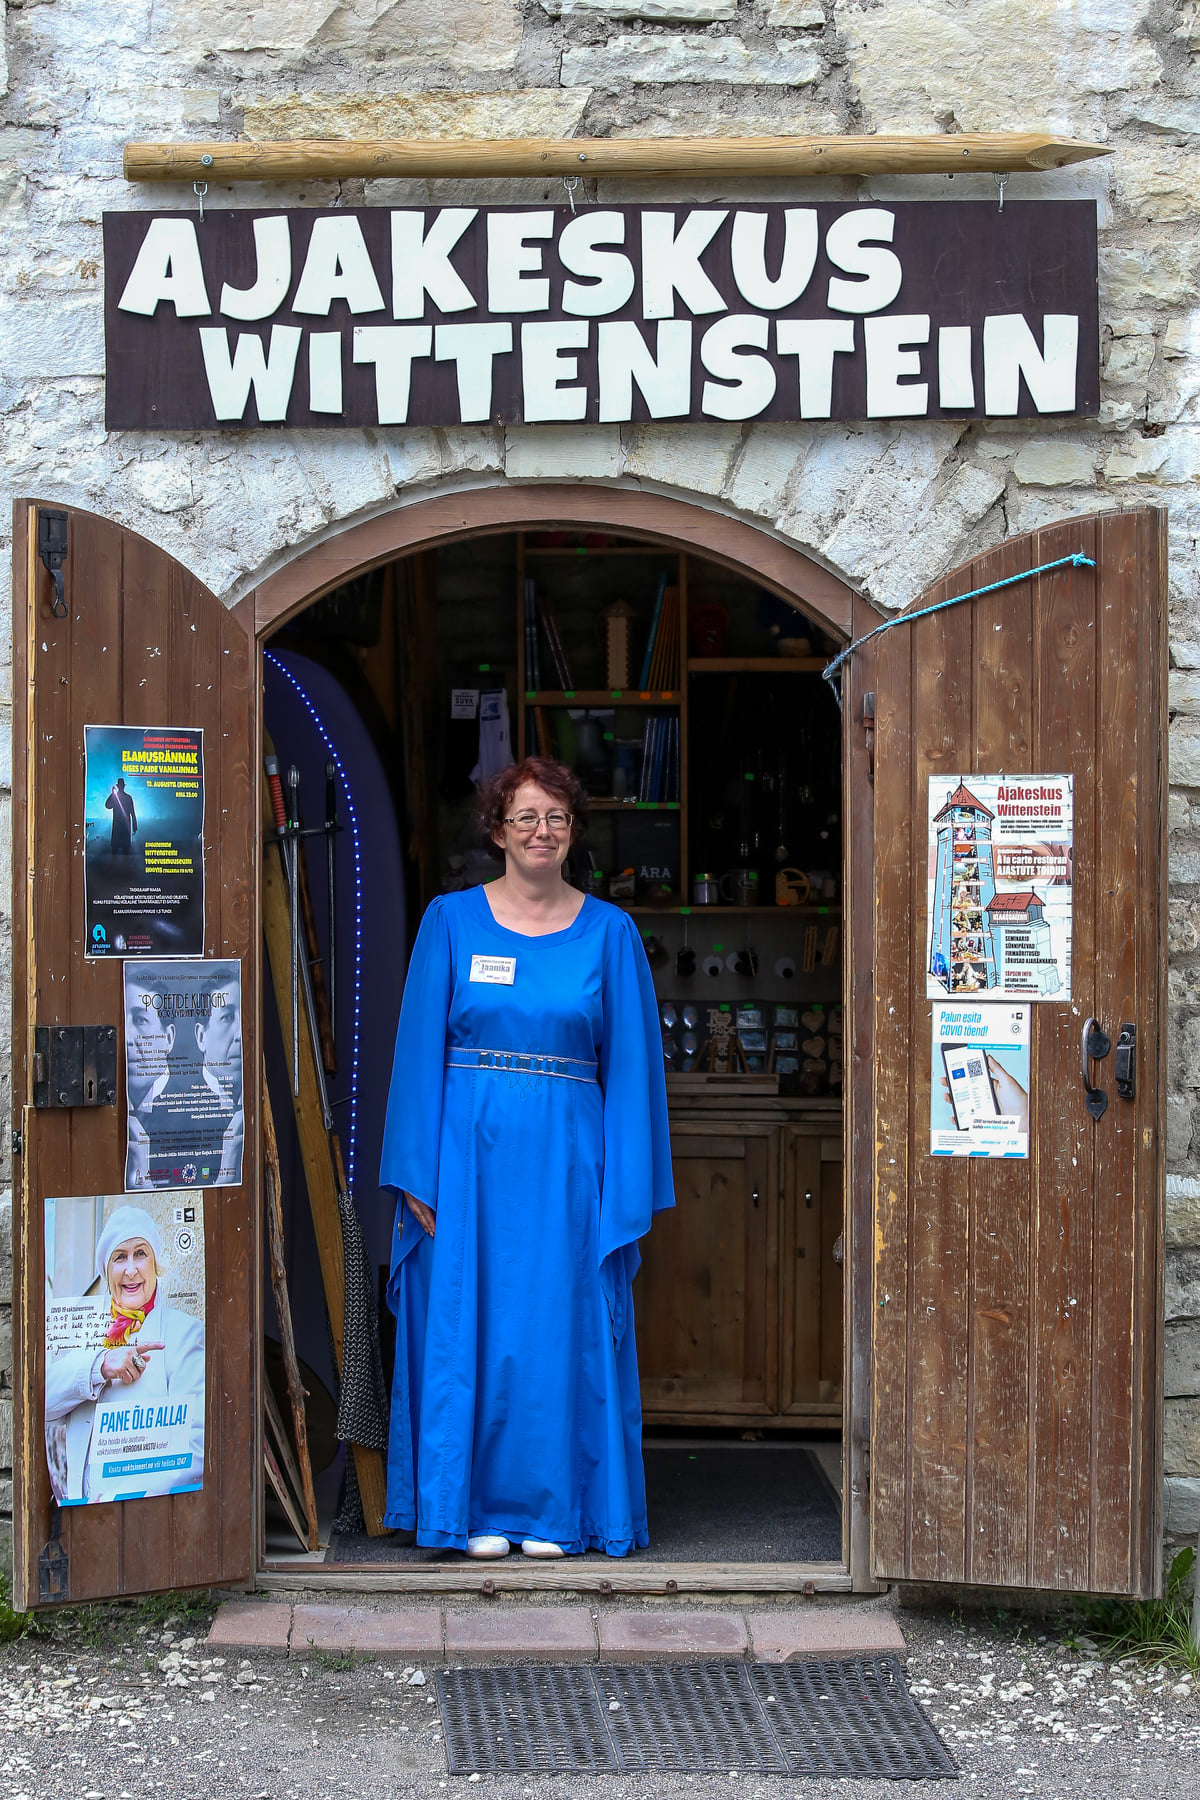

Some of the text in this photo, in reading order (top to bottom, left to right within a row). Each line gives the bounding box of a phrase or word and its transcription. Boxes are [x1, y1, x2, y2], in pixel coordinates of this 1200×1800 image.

[118, 207, 902, 320] AJAKESKUS
[199, 314, 1079, 425] WITTENSTEIN
[122, 750, 198, 764] ELAMUSRÄNNAK
[140, 765, 158, 773] PAIDE
[159, 765, 198, 774] VANALINNAS
[997, 786, 1062, 802] Ajakeskus
[997, 804, 1062, 816] Wittenstein
[1003, 855, 1011, 864] la
[1011, 855, 1033, 864] carte
[1033, 855, 1067, 864] restoran
[640, 864, 672, 879] ÄRA
[997, 865, 1067, 876] AJASTUTE TOIDUD
[940, 1011, 982, 1023] Palun esita
[940, 1025, 989, 1037] COVID tõend!
[99, 1403, 188, 1434] PANE ÕLG ALLA!
